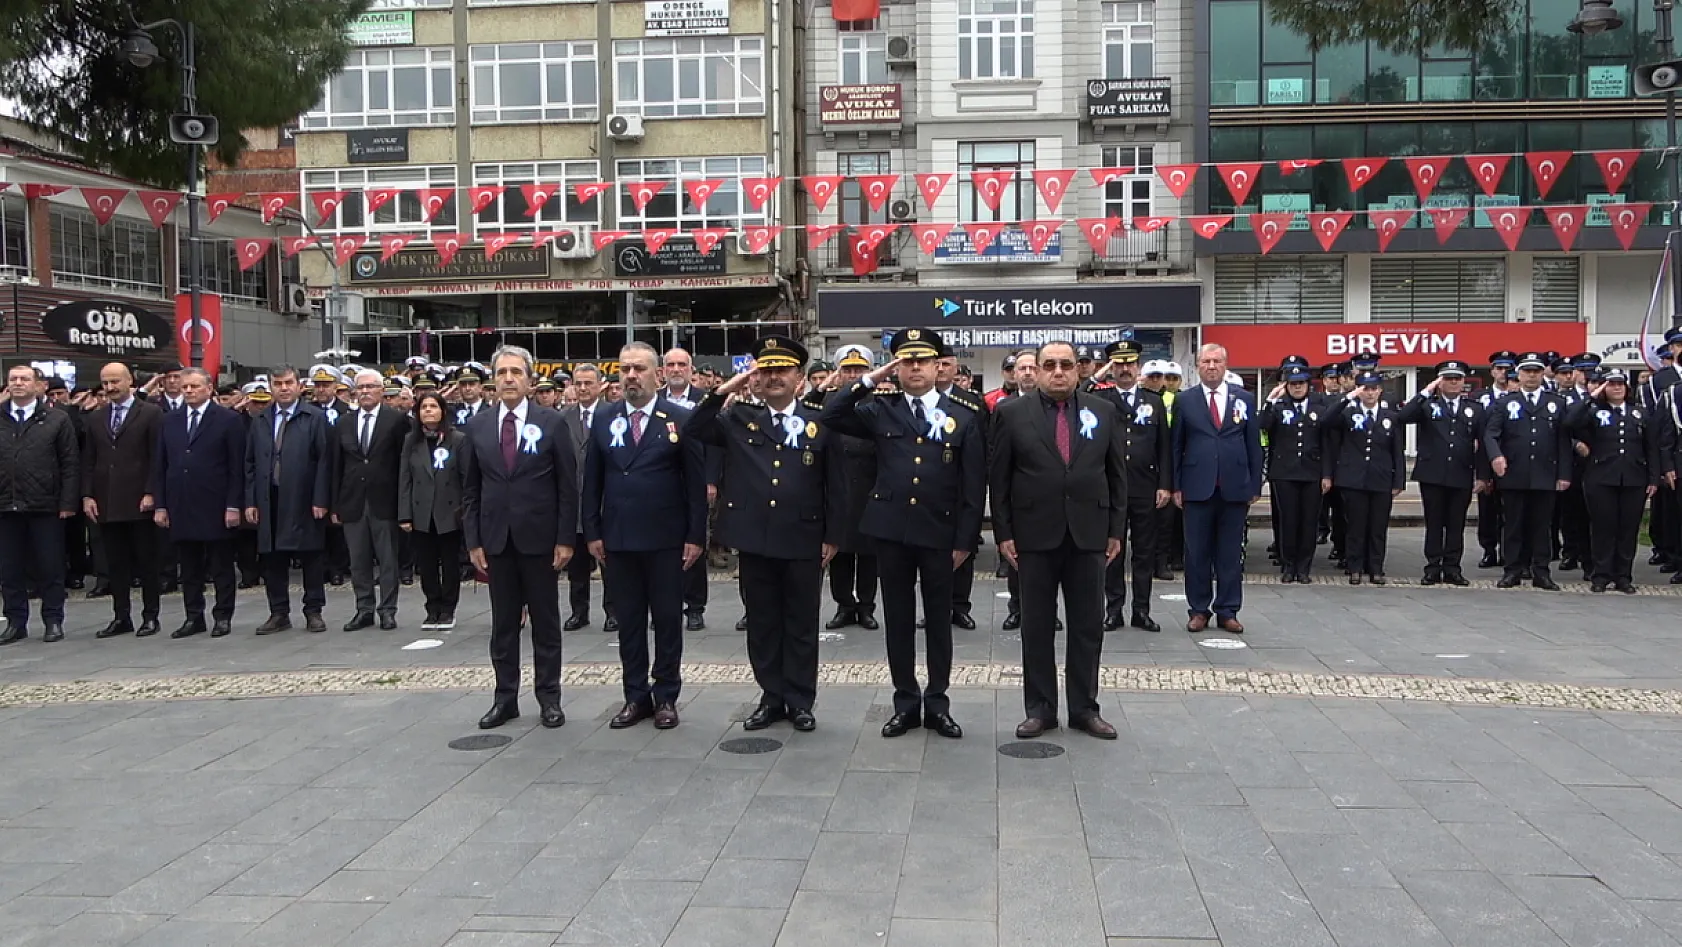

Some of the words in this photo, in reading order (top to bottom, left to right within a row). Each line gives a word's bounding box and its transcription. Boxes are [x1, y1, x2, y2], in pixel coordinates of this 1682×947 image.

[672, 2, 704, 10] DENGE
[650, 11, 683, 19] HUKUK
[686, 9, 724, 17] BÜROSU
[1117, 91, 1163, 102] AVUKAT
[834, 100, 895, 109] AVUKAT
[1090, 104, 1117, 115] FUAT
[1119, 103, 1170, 114] SARIKAYA
[422, 252, 464, 265] MEAL
[469, 249, 540, 264] SEDİKASI
[629, 279, 664, 288] KEBAP
[680, 277, 733, 287] KAHVALTI
[749, 276, 770, 285] 7/24
[963, 299, 1006, 316] Türk
[1011, 298, 1094, 316] Telekom
[86, 309, 139, 334] OBA
[69, 327, 156, 349] Restaurant
[972, 327, 1021, 346] İNTERNET
[1073, 328, 1120, 344] NOKTASI
